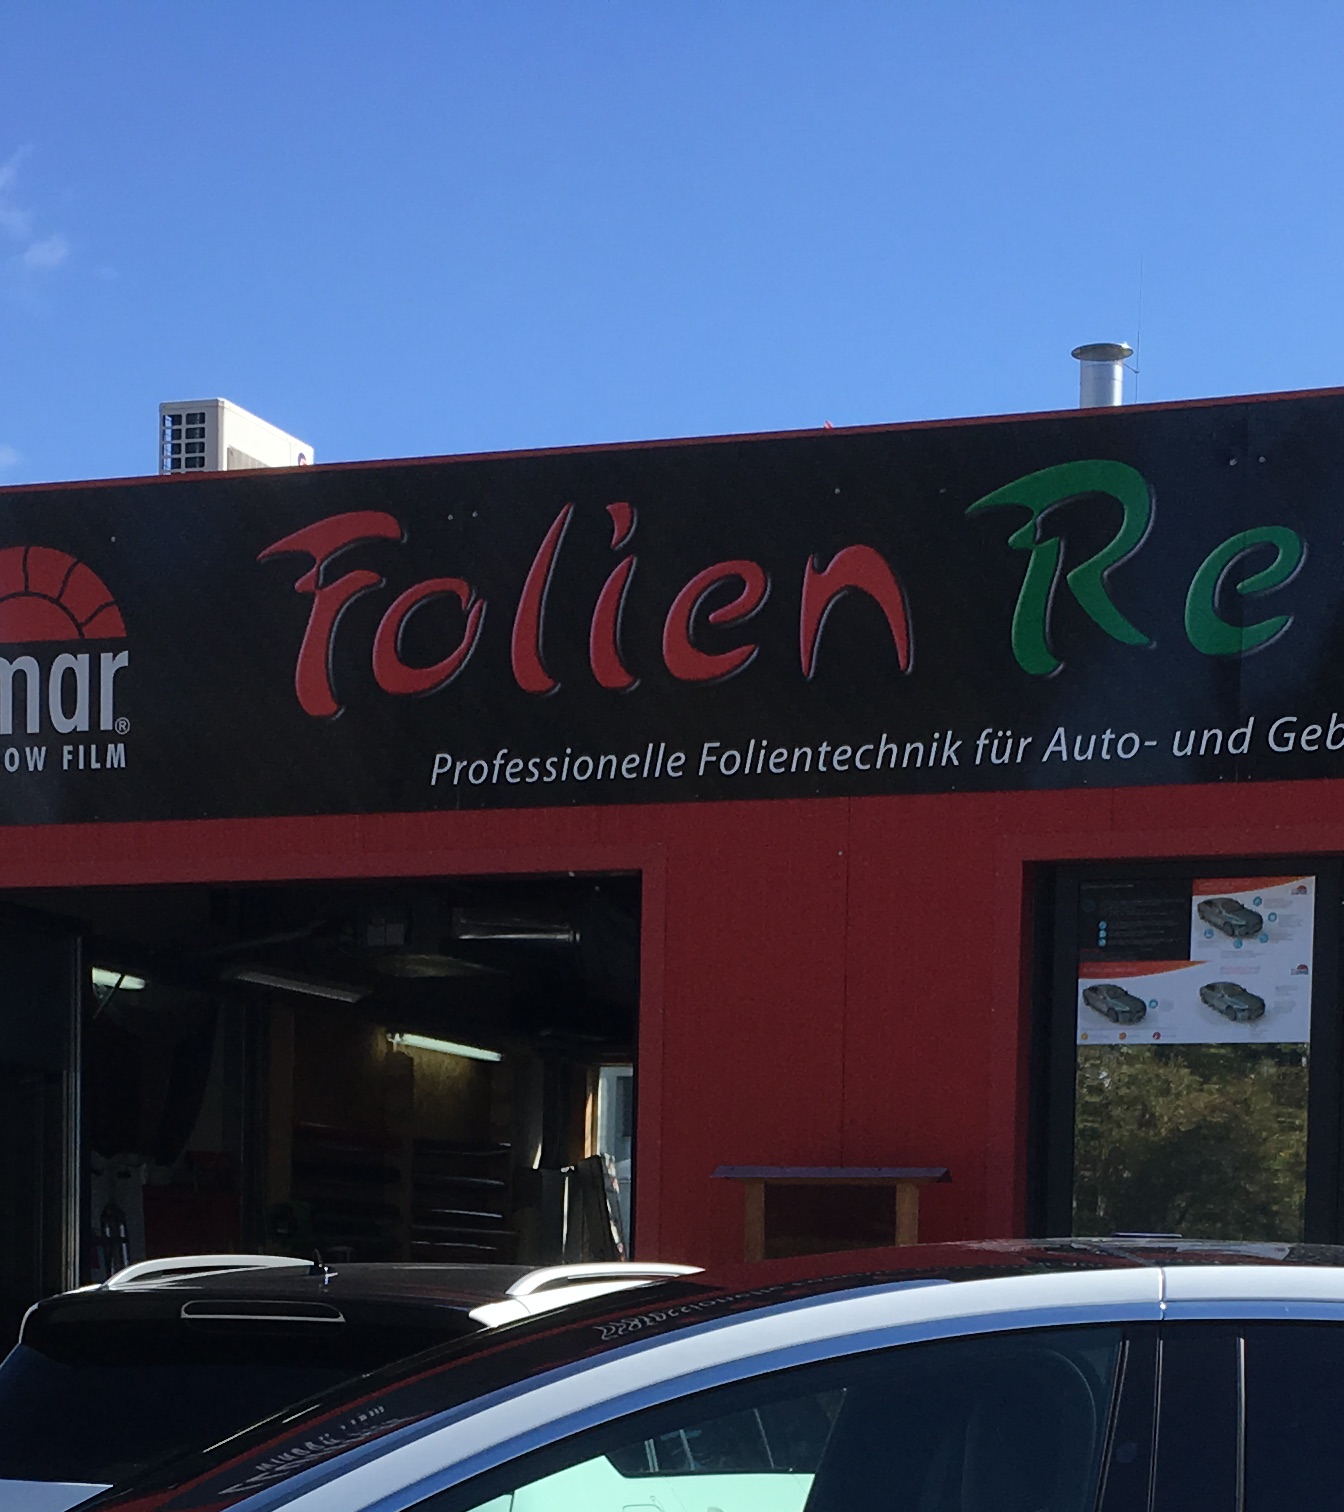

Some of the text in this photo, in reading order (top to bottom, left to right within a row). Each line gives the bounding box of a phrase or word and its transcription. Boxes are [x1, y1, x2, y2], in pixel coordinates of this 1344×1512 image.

[258, 500, 913, 719] Folien
[62, 743, 127, 770] FILM
[430, 741, 686, 787] Professionelle
[697, 732, 962, 778] Folientechnik
[975, 727, 1032, 768] für
[1042, 725, 1159, 763] Auto-
[1171, 716, 1257, 756] und
